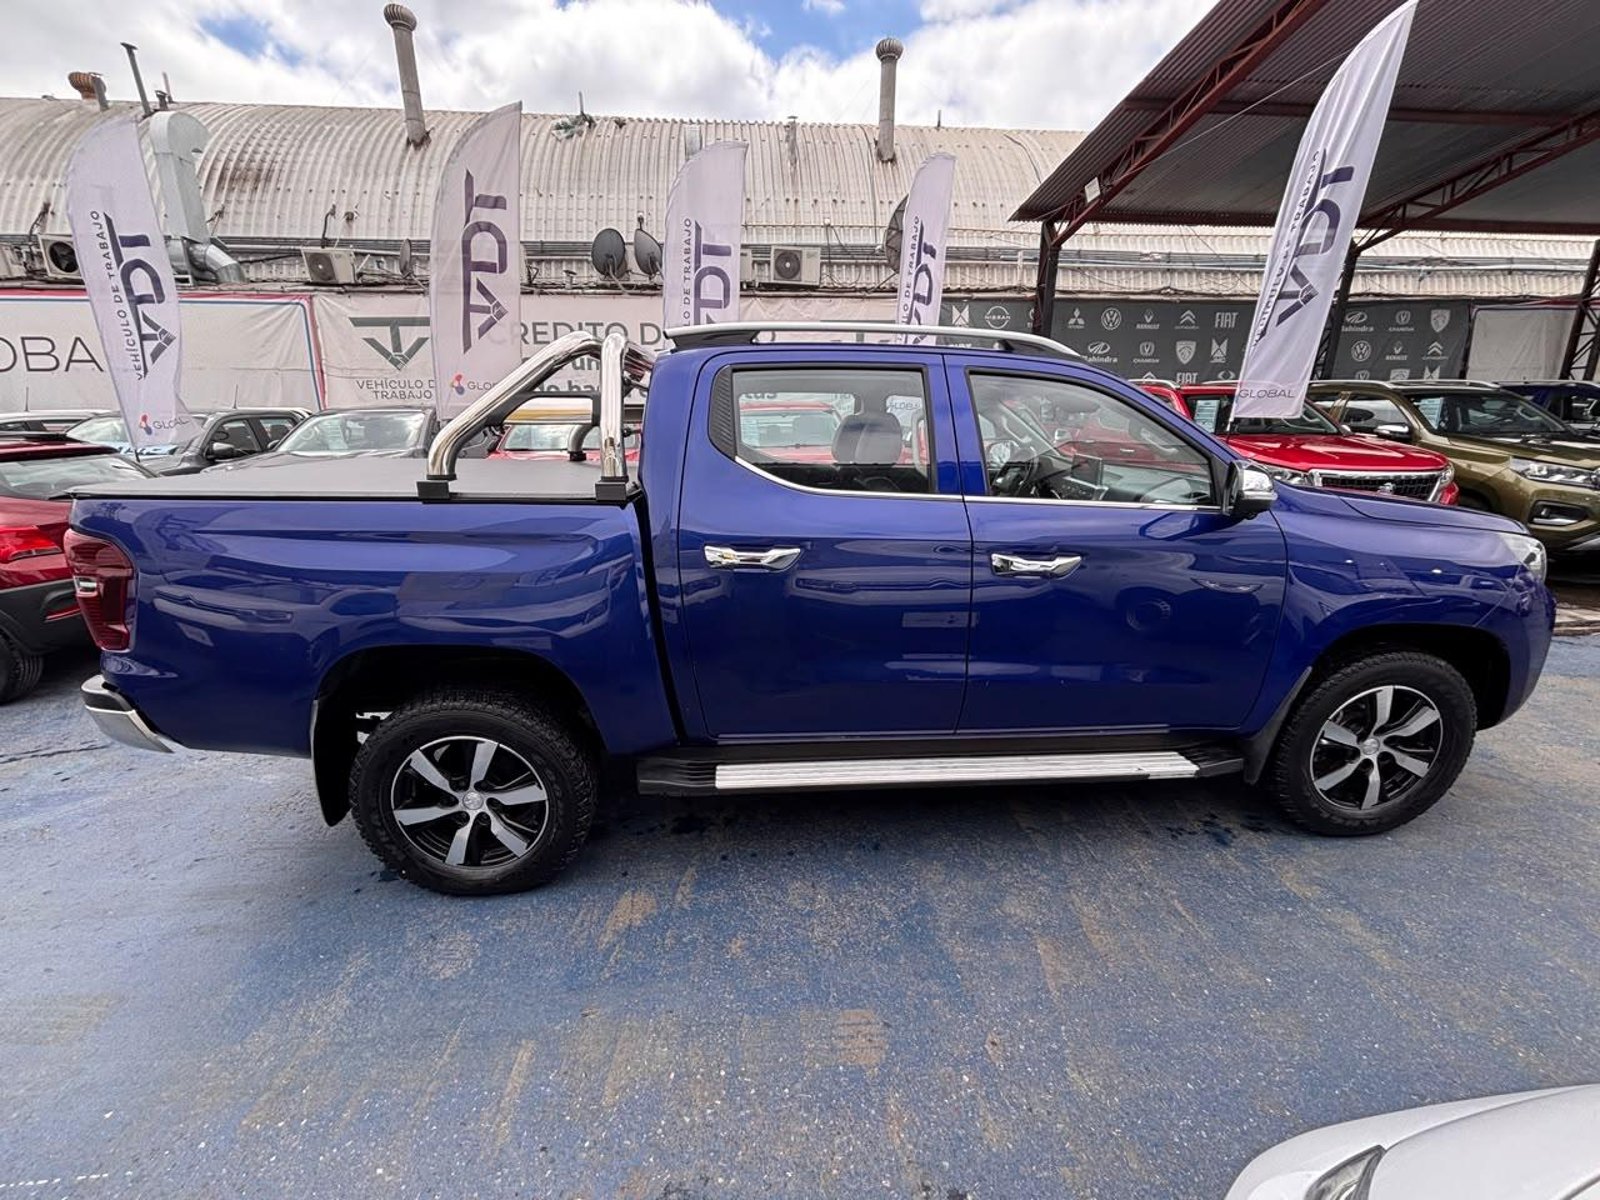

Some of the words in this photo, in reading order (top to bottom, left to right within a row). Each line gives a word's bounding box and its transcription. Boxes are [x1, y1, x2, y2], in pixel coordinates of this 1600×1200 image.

[90, 210, 116, 280] TRABAJO
[683, 218, 692, 283] TRABAJO
[111, 284, 123, 303] DE
[683, 287, 691, 305] DE
[1214, 312, 1239, 329] FIAT
[356, 378, 424, 390] VEHÍCULO
[1176, 372, 1199, 384] FIAT
[372, 390, 433, 400] TRABAJO
[1238, 388, 1295, 399] GLOBAL
